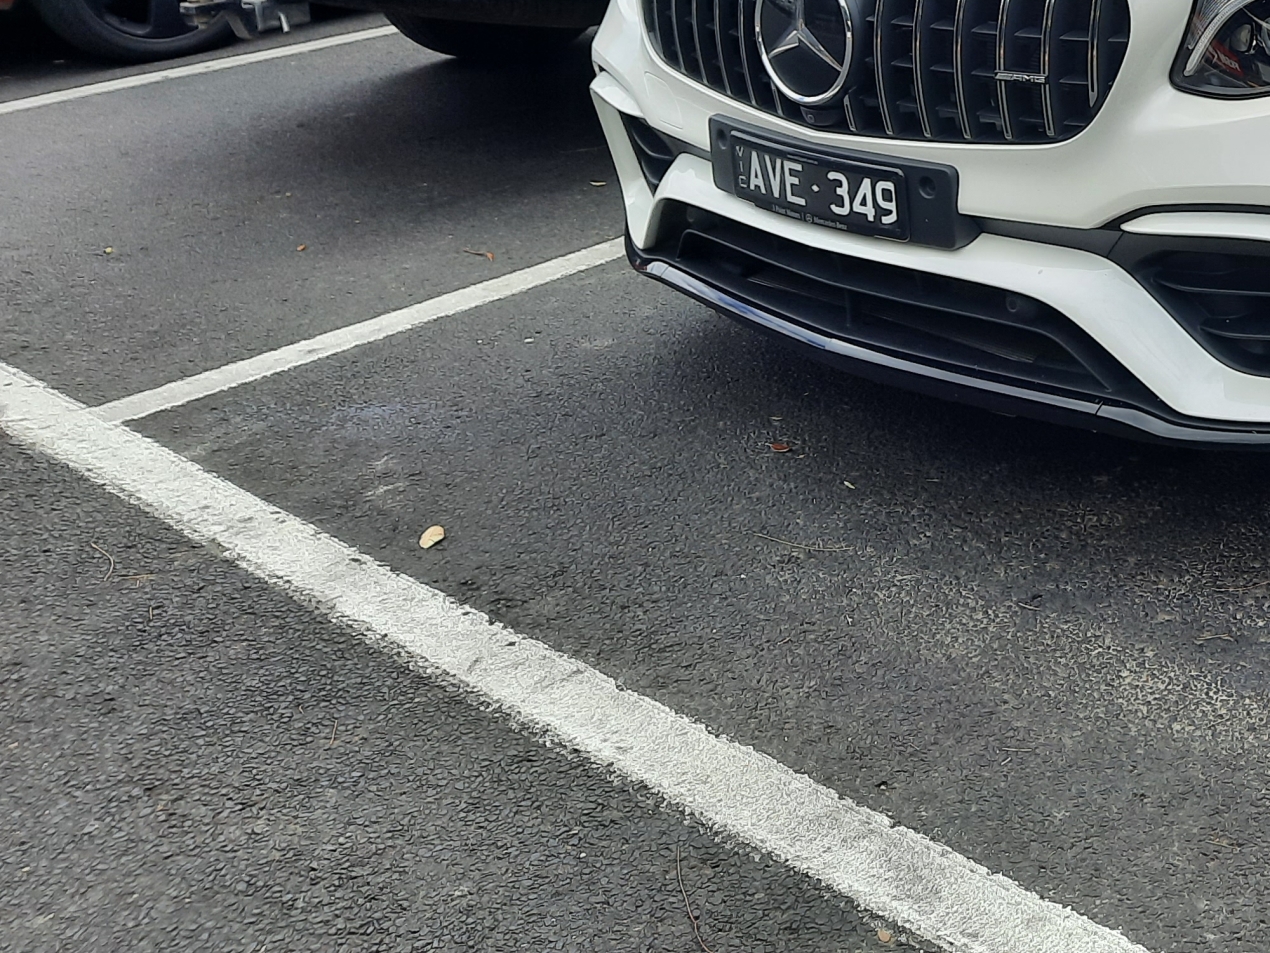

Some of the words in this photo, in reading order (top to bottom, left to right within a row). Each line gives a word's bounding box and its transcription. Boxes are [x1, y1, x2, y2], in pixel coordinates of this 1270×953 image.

[735, 145, 748, 189] VIC
[750, 150, 807, 207] AVE
[827, 171, 898, 226] 349
